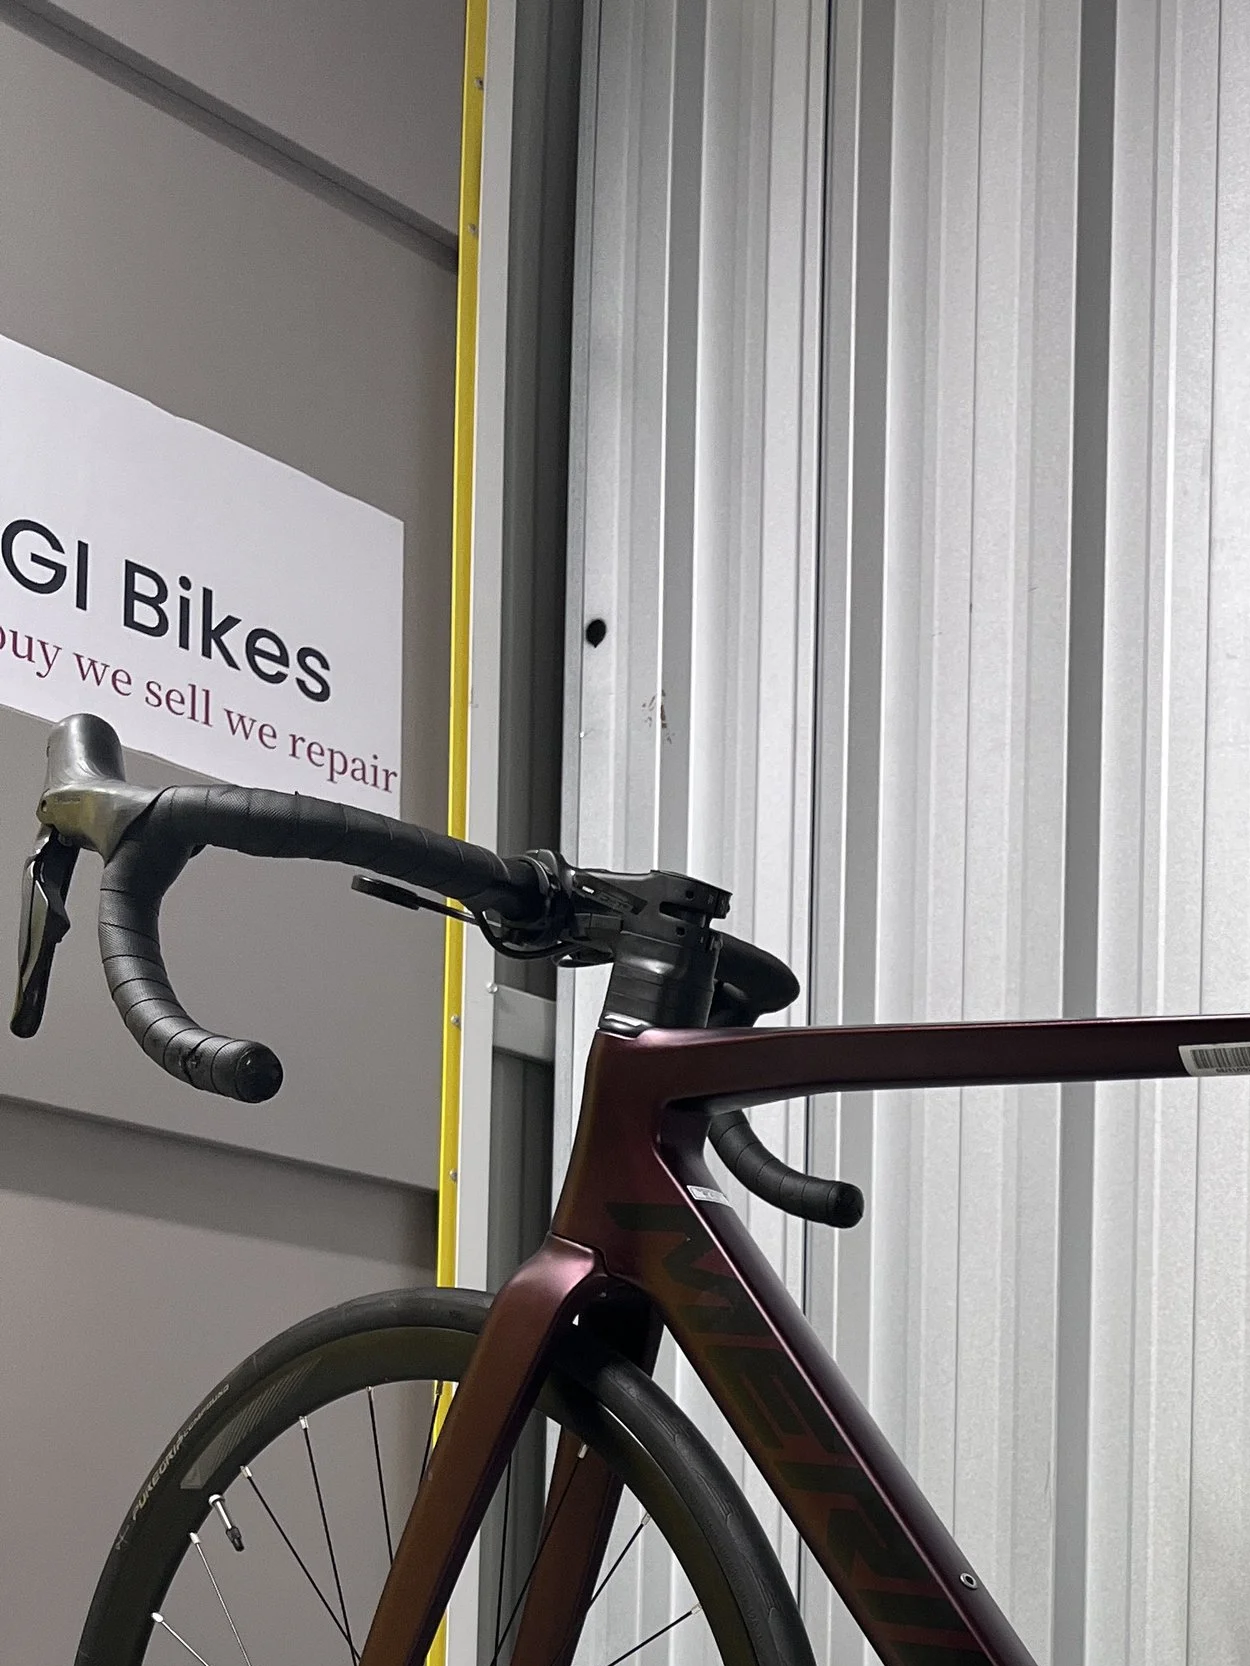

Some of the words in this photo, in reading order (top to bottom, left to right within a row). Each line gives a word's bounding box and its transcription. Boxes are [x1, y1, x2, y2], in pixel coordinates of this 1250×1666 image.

[0, 518, 89, 611] GI
[122, 558, 332, 703] Bikes
[73, 652, 133, 697] we
[144, 680, 214, 728] sell
[223, 707, 277, 750] we
[288, 733, 398, 793] repair
